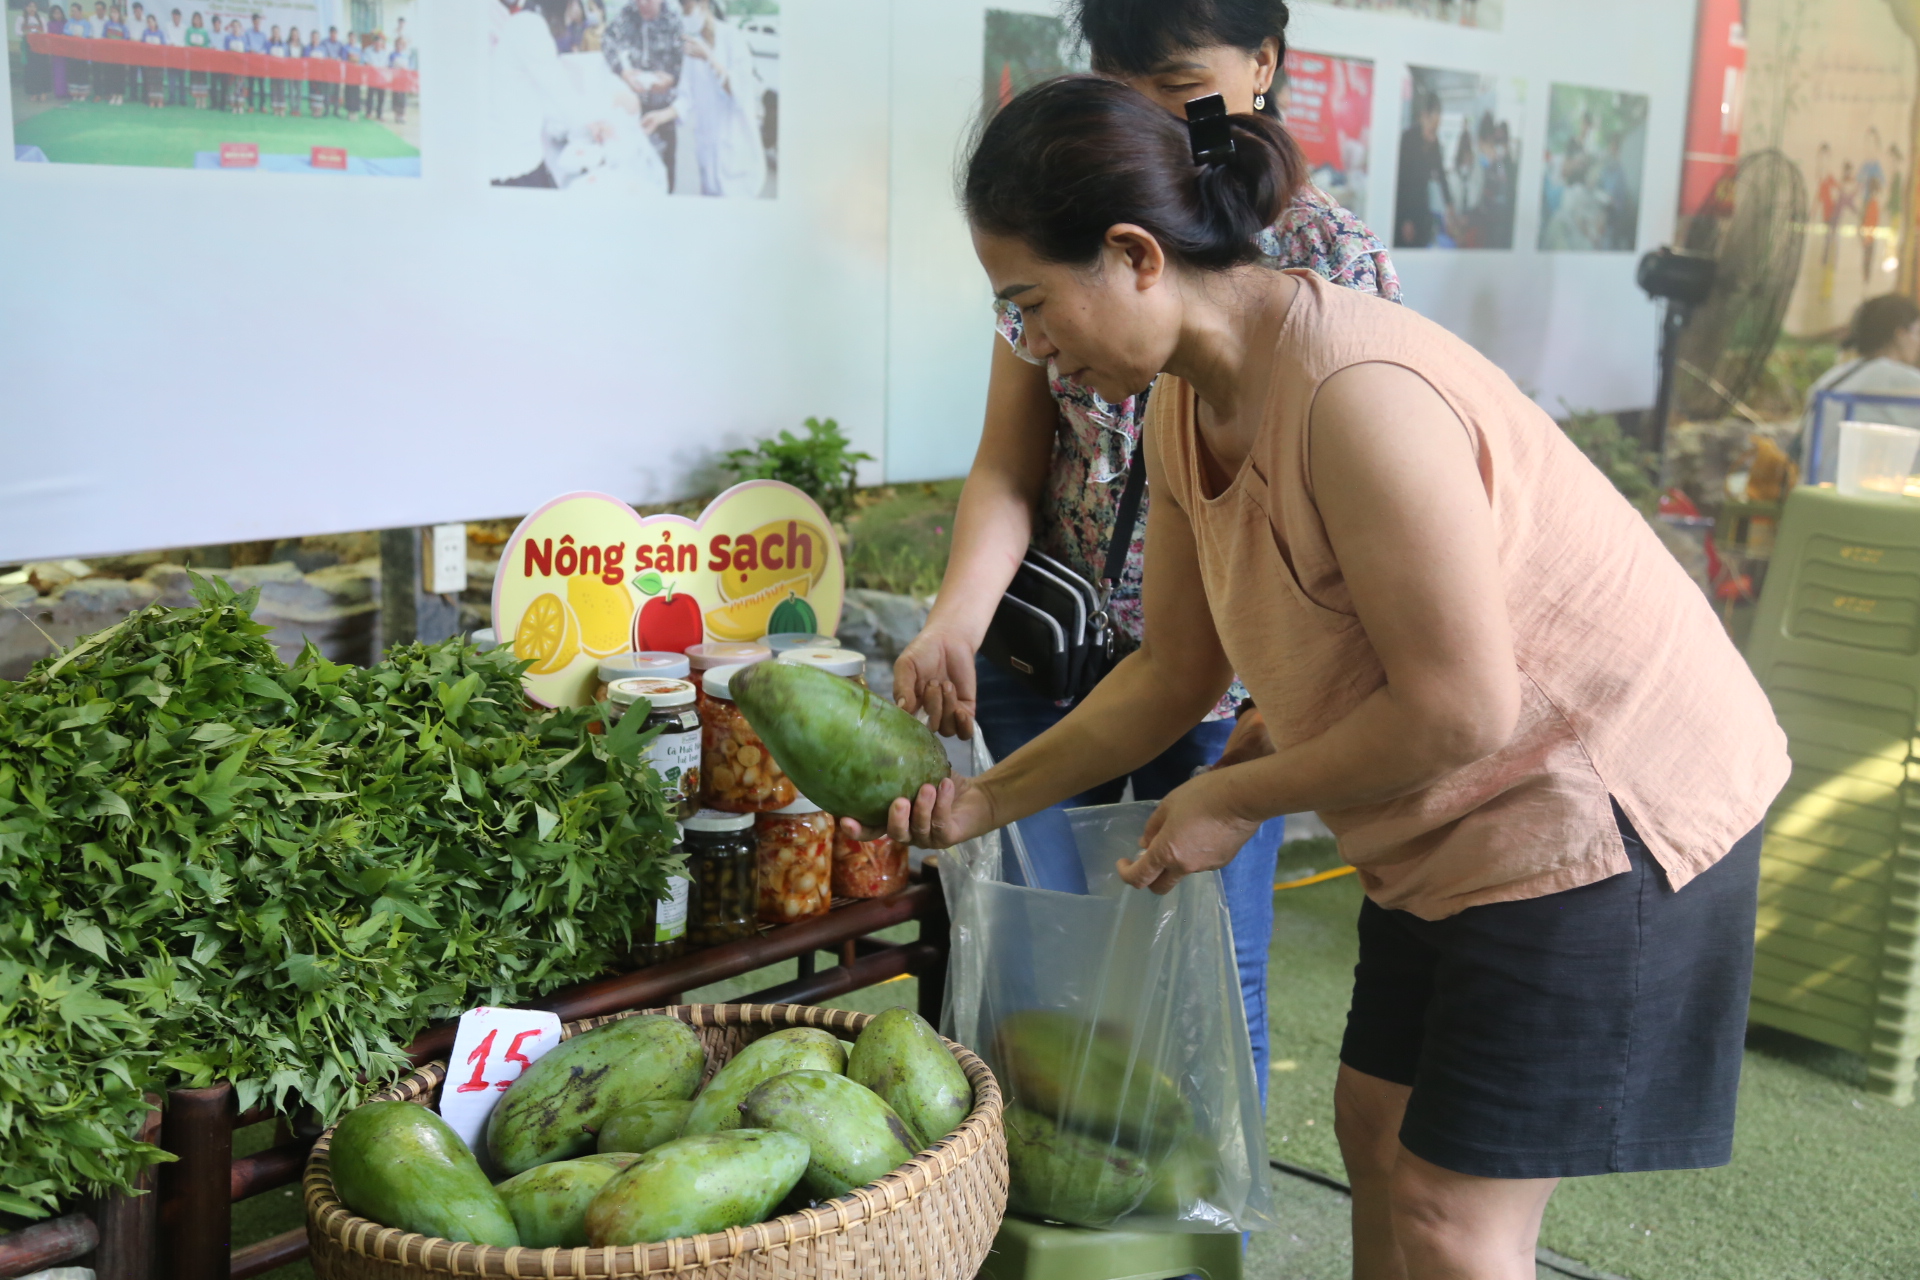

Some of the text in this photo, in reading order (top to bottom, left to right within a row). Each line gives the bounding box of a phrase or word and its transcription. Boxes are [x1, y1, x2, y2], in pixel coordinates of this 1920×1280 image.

[524, 521, 813, 586] Nông sản sạch
[457, 1029, 542, 1093] 15
